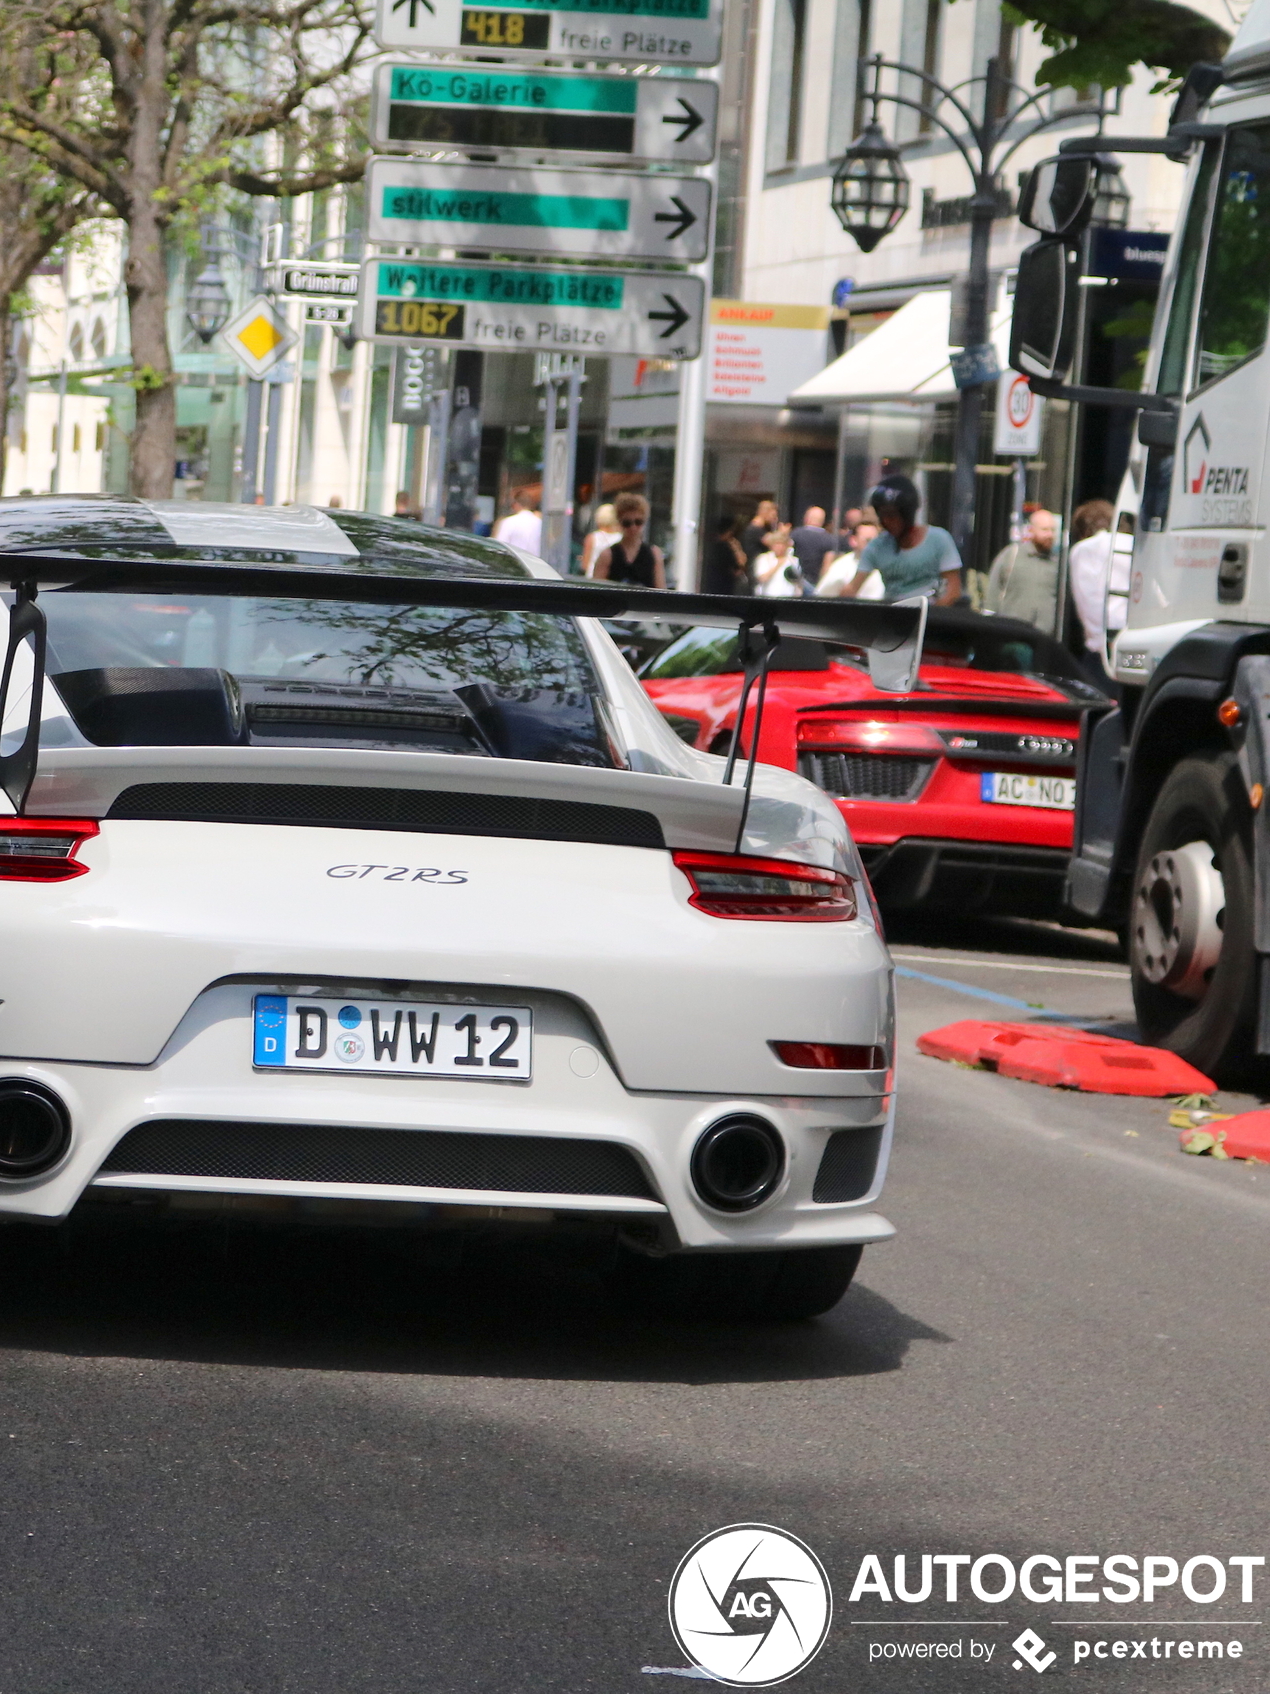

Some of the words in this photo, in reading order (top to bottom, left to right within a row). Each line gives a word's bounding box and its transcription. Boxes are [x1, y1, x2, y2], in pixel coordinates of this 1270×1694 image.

[467, 14, 525, 45] 418
[560, 28, 613, 50] freie
[623, 32, 693, 56] Plätze
[398, 71, 548, 104] Kö-Galerie
[392, 193, 503, 219] stilwerk
[489, 272, 616, 304] Parkplätze
[381, 305, 460, 337] 1067
[474, 318, 526, 341] freie
[537, 321, 606, 346] Plätze
[1012, 391, 1030, 414] 30
[1206, 467, 1250, 494] PENTA
[1201, 500, 1253, 523] SYSTEMS
[998, 777, 1023, 800] AC
[264, 1037, 277, 1053] D
[295, 1005, 328, 1059] D
[370, 1009, 441, 1064] WW
[454, 1013, 520, 1068] 12
